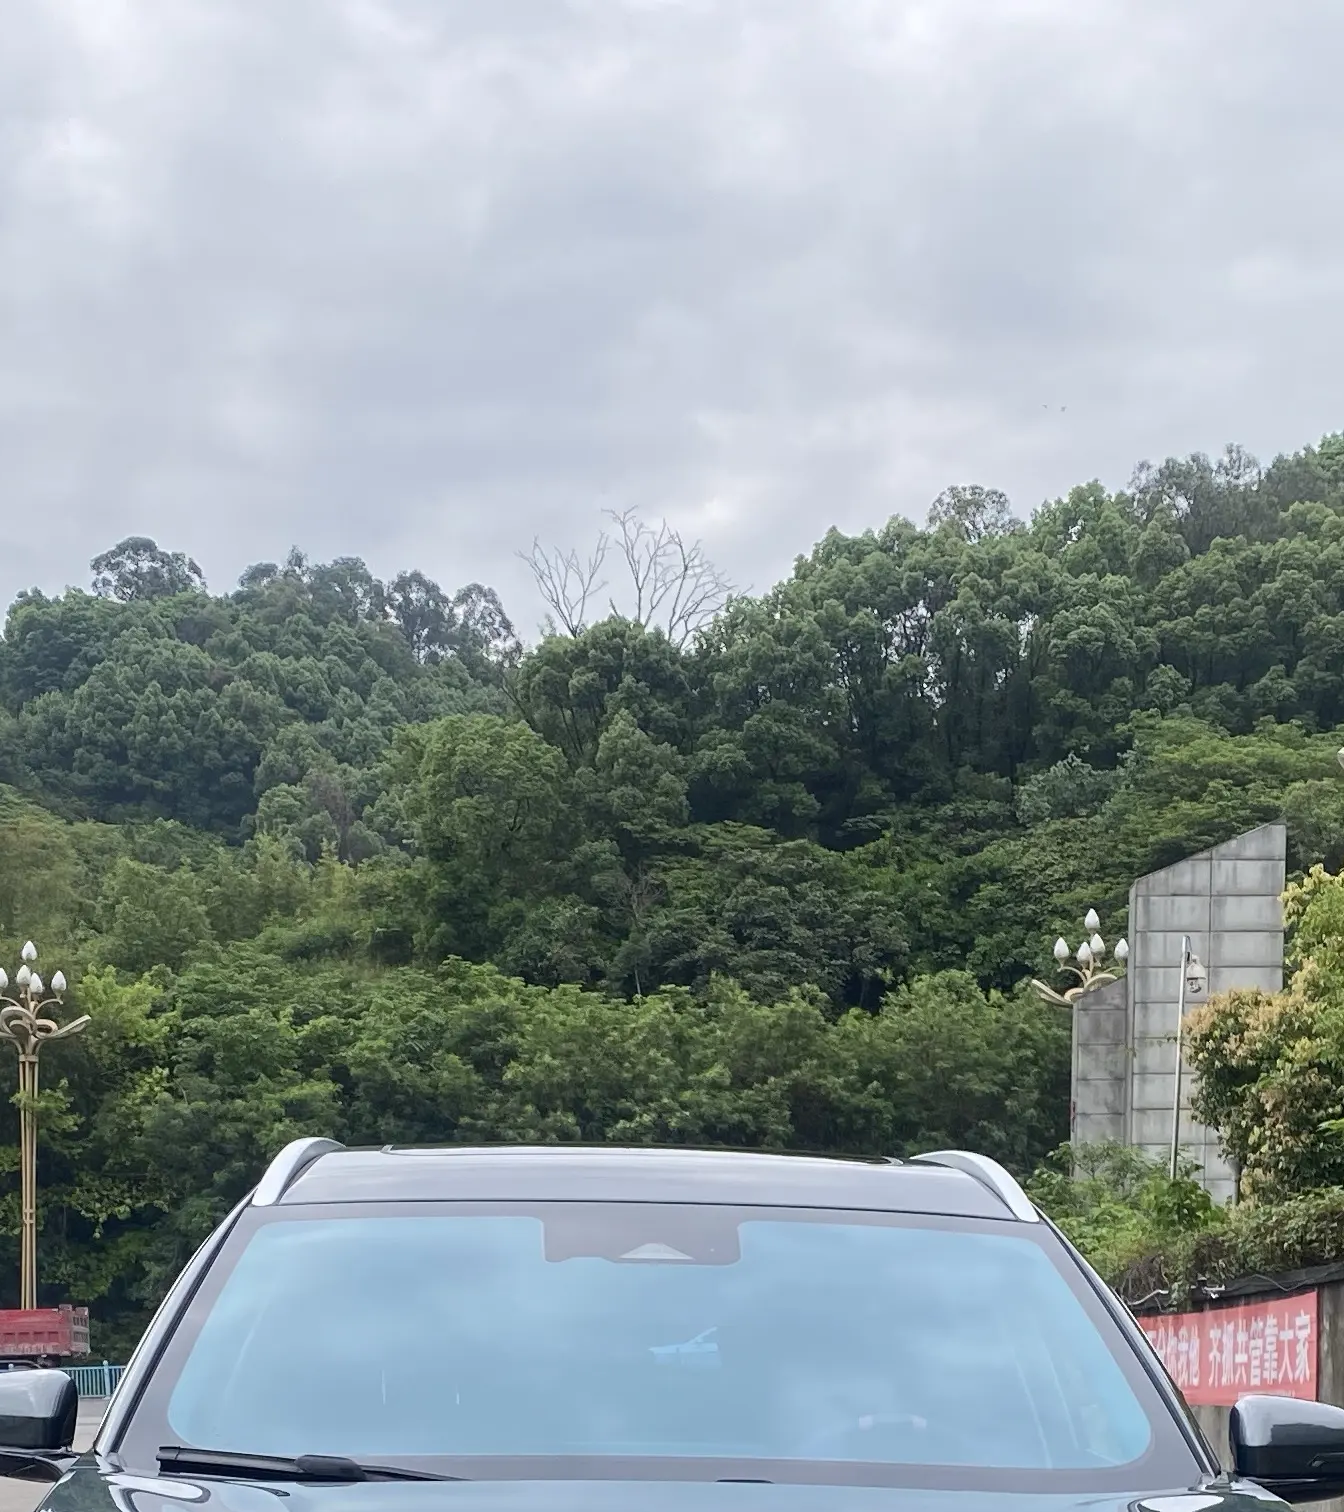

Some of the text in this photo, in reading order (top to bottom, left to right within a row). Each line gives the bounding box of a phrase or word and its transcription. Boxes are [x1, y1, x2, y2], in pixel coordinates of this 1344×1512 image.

[1208, 1309, 1311, 1388] 齐抓共管靠大家
